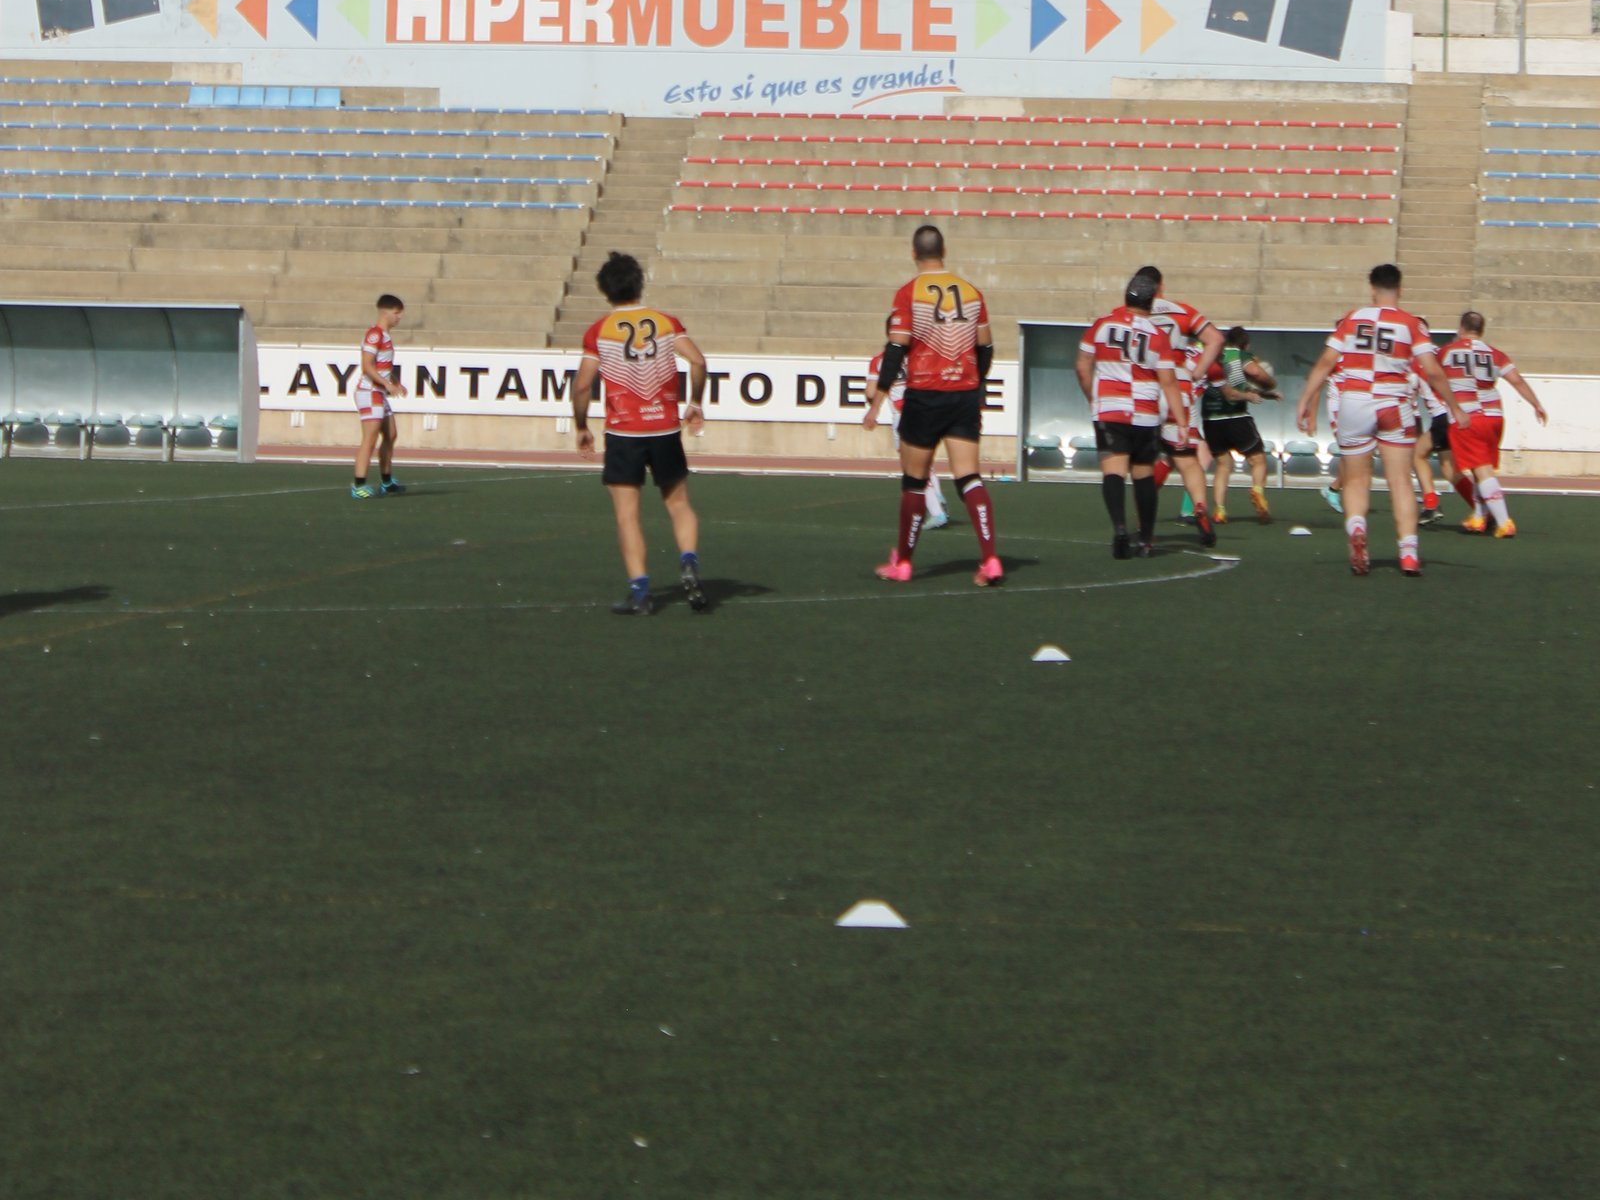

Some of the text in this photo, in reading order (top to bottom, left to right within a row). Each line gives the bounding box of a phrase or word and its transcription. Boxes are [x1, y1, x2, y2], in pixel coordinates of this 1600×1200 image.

[663, 79, 722, 104] Esto
[761, 79, 807, 106] que
[815, 76, 842, 94] es
[851, 59, 957, 98] grande!
[927, 284, 969, 323] 21
[616, 317, 658, 361] 23
[1106, 325, 1149, 364] 41
[1355, 323, 1396, 353] 56
[1452, 352, 1494, 379] 44
